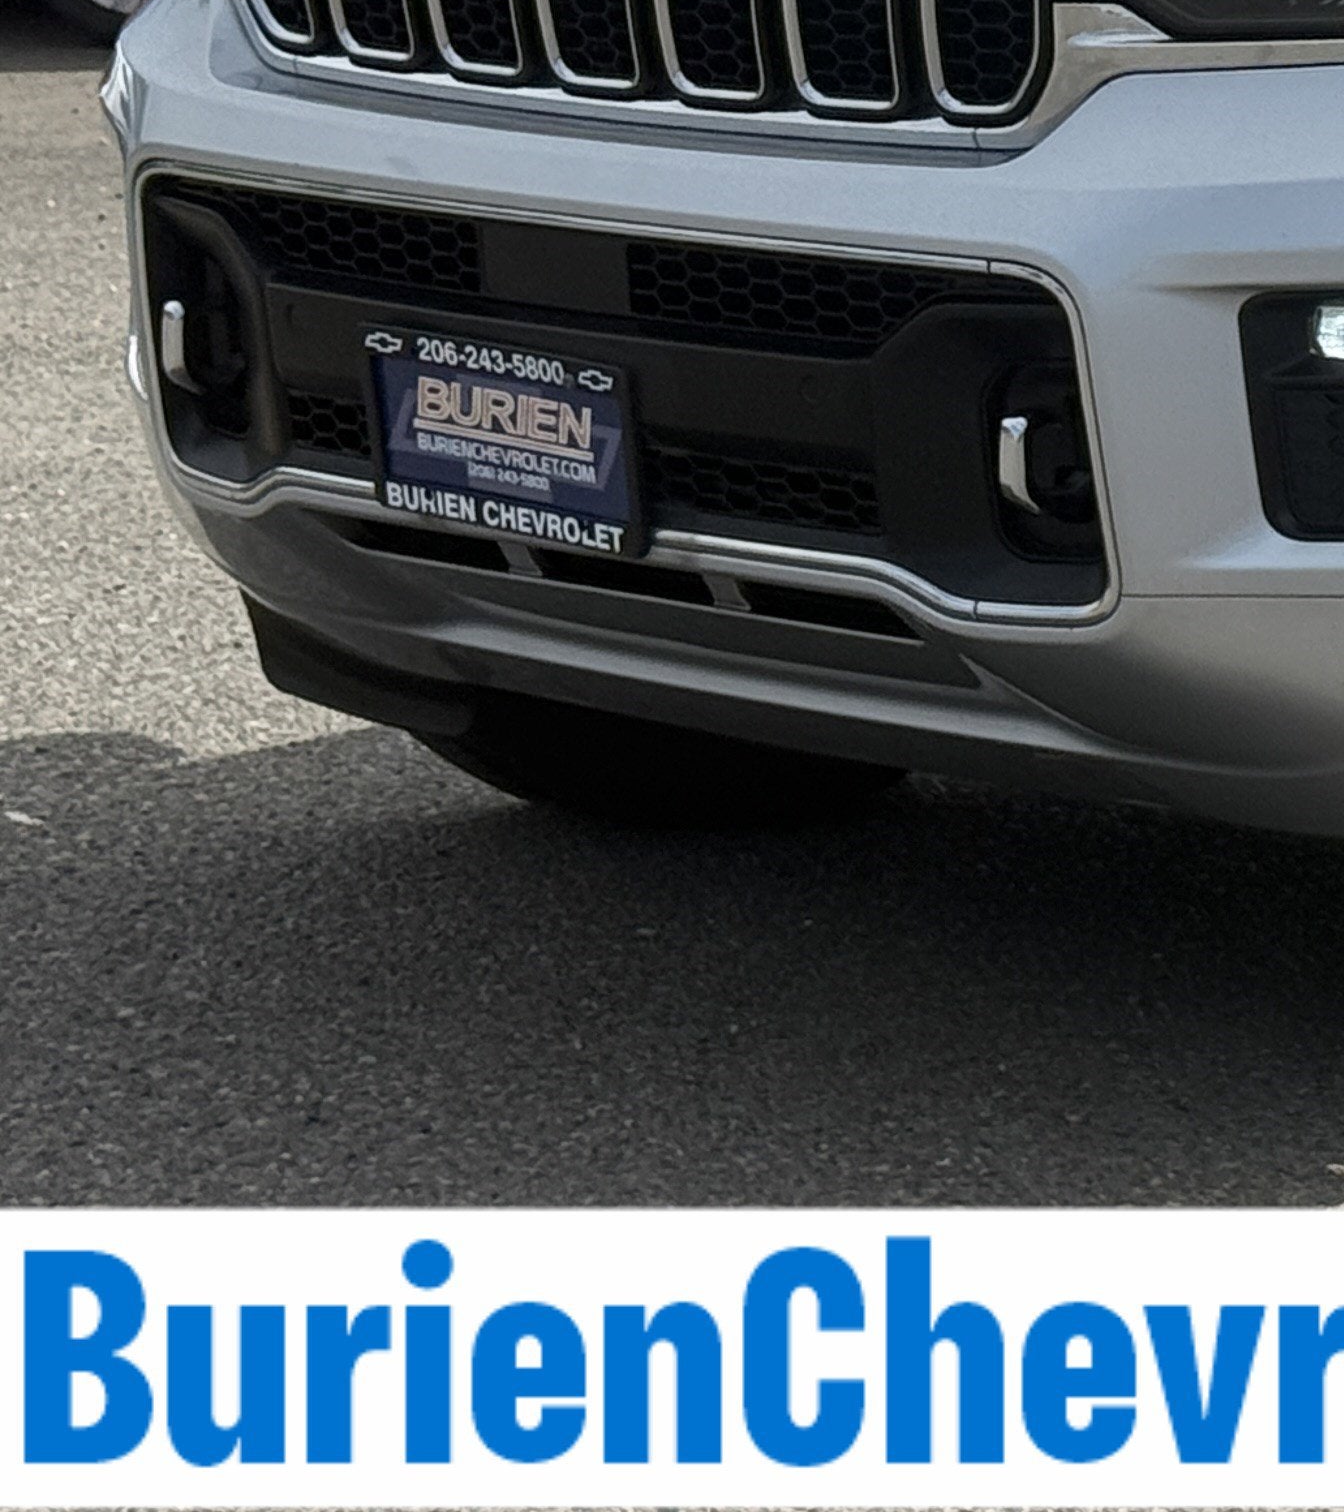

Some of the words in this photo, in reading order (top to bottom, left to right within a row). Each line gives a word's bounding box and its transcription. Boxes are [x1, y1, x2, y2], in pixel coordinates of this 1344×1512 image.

[416, 337, 565, 386] 206-243-5800
[416, 375, 592, 449] BURIEN
[416, 432, 597, 484] BURIENCHEVROLET.COM
